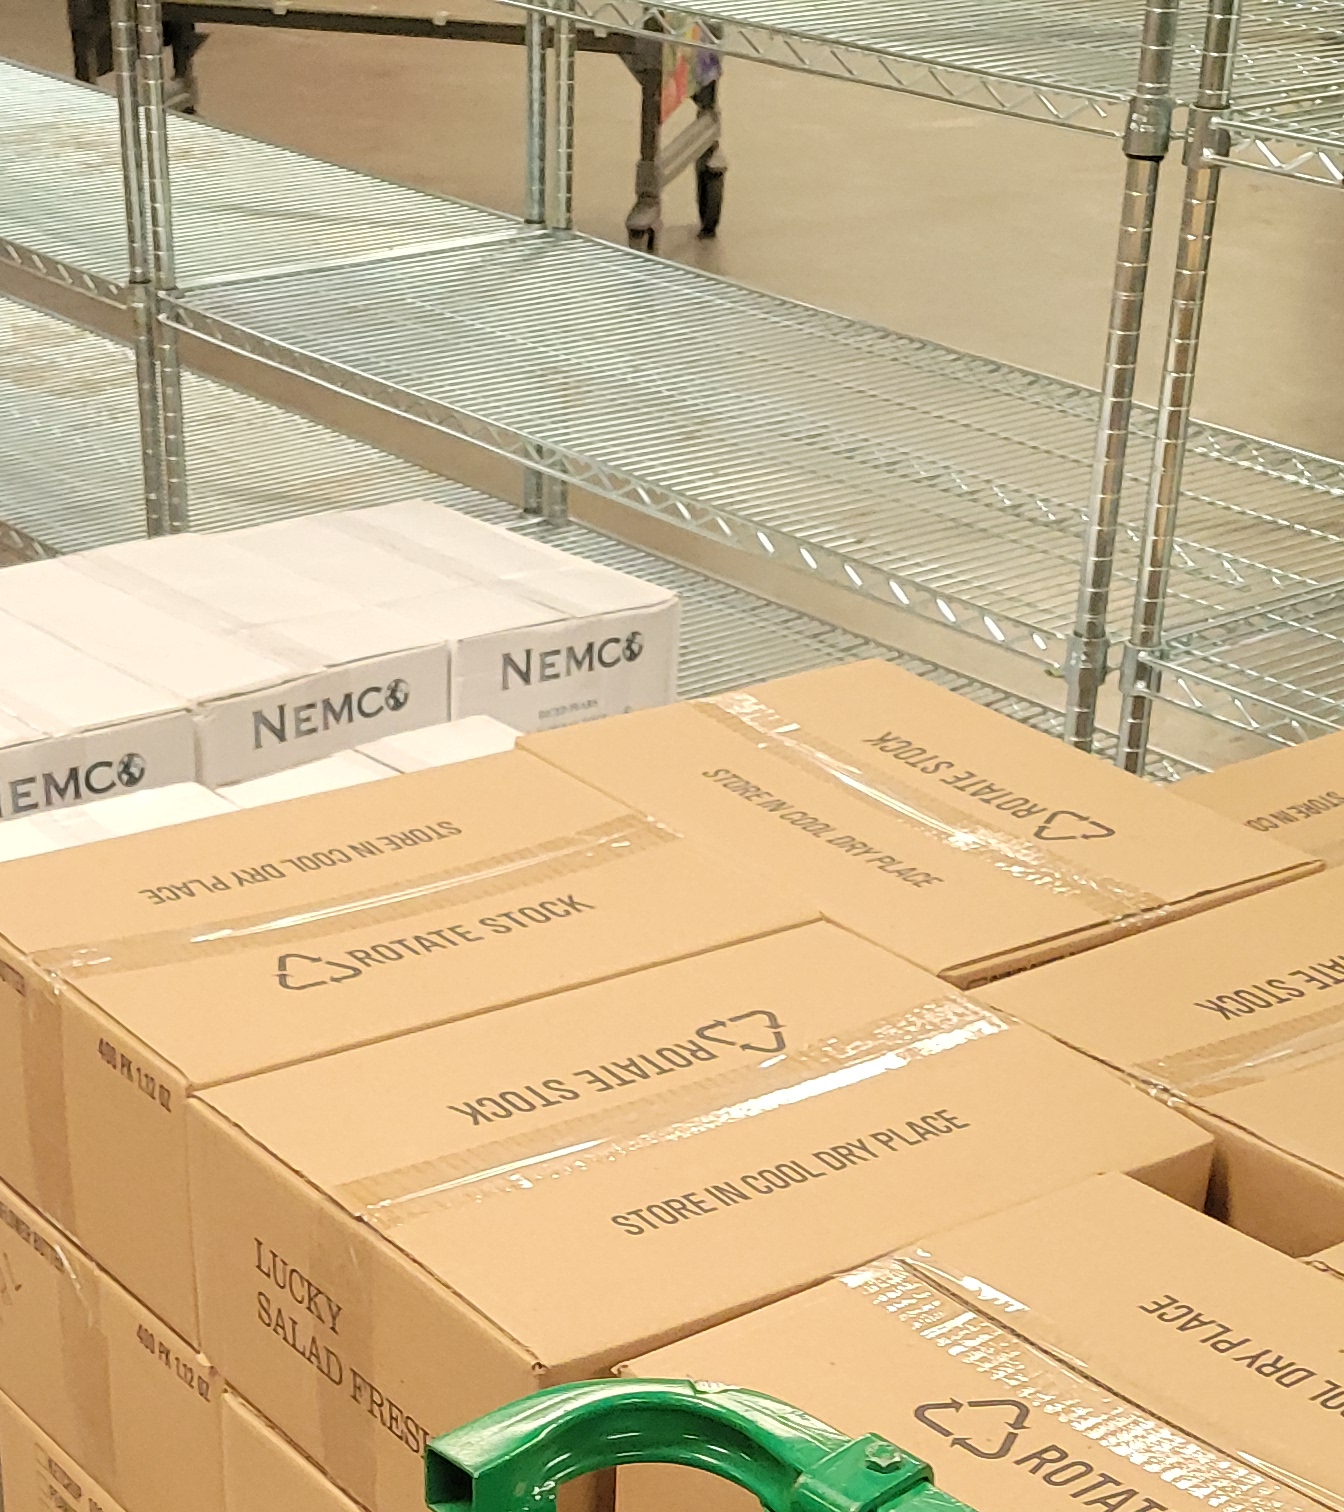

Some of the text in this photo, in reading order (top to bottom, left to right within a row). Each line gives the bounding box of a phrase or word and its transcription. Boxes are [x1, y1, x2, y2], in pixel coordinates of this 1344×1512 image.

[501, 631, 643, 691] NEMCO
[253, 678, 410, 749] NEMCO
[862, 730, 1049, 820] ROTATE STOCK
[137, 820, 463, 906] STORE IN COOL DRY PLACE
[701, 768, 945, 889] STORE IN COOL DRY PLACE
[344, 894, 595, 968] ROTATE STOCK
[1193, 979, 1306, 1021] STOCK
[447, 1039, 720, 1126] ROTATE STOCK
[610, 1108, 971, 1236] STORE IN COOL DRY PLACE
[254, 1237, 344, 1336] LUCKY
[1137, 1294, 1252, 1354] PLACE
[256, 1292, 343, 1388] SALAD
[1231, 1348, 1318, 1389] DRY
